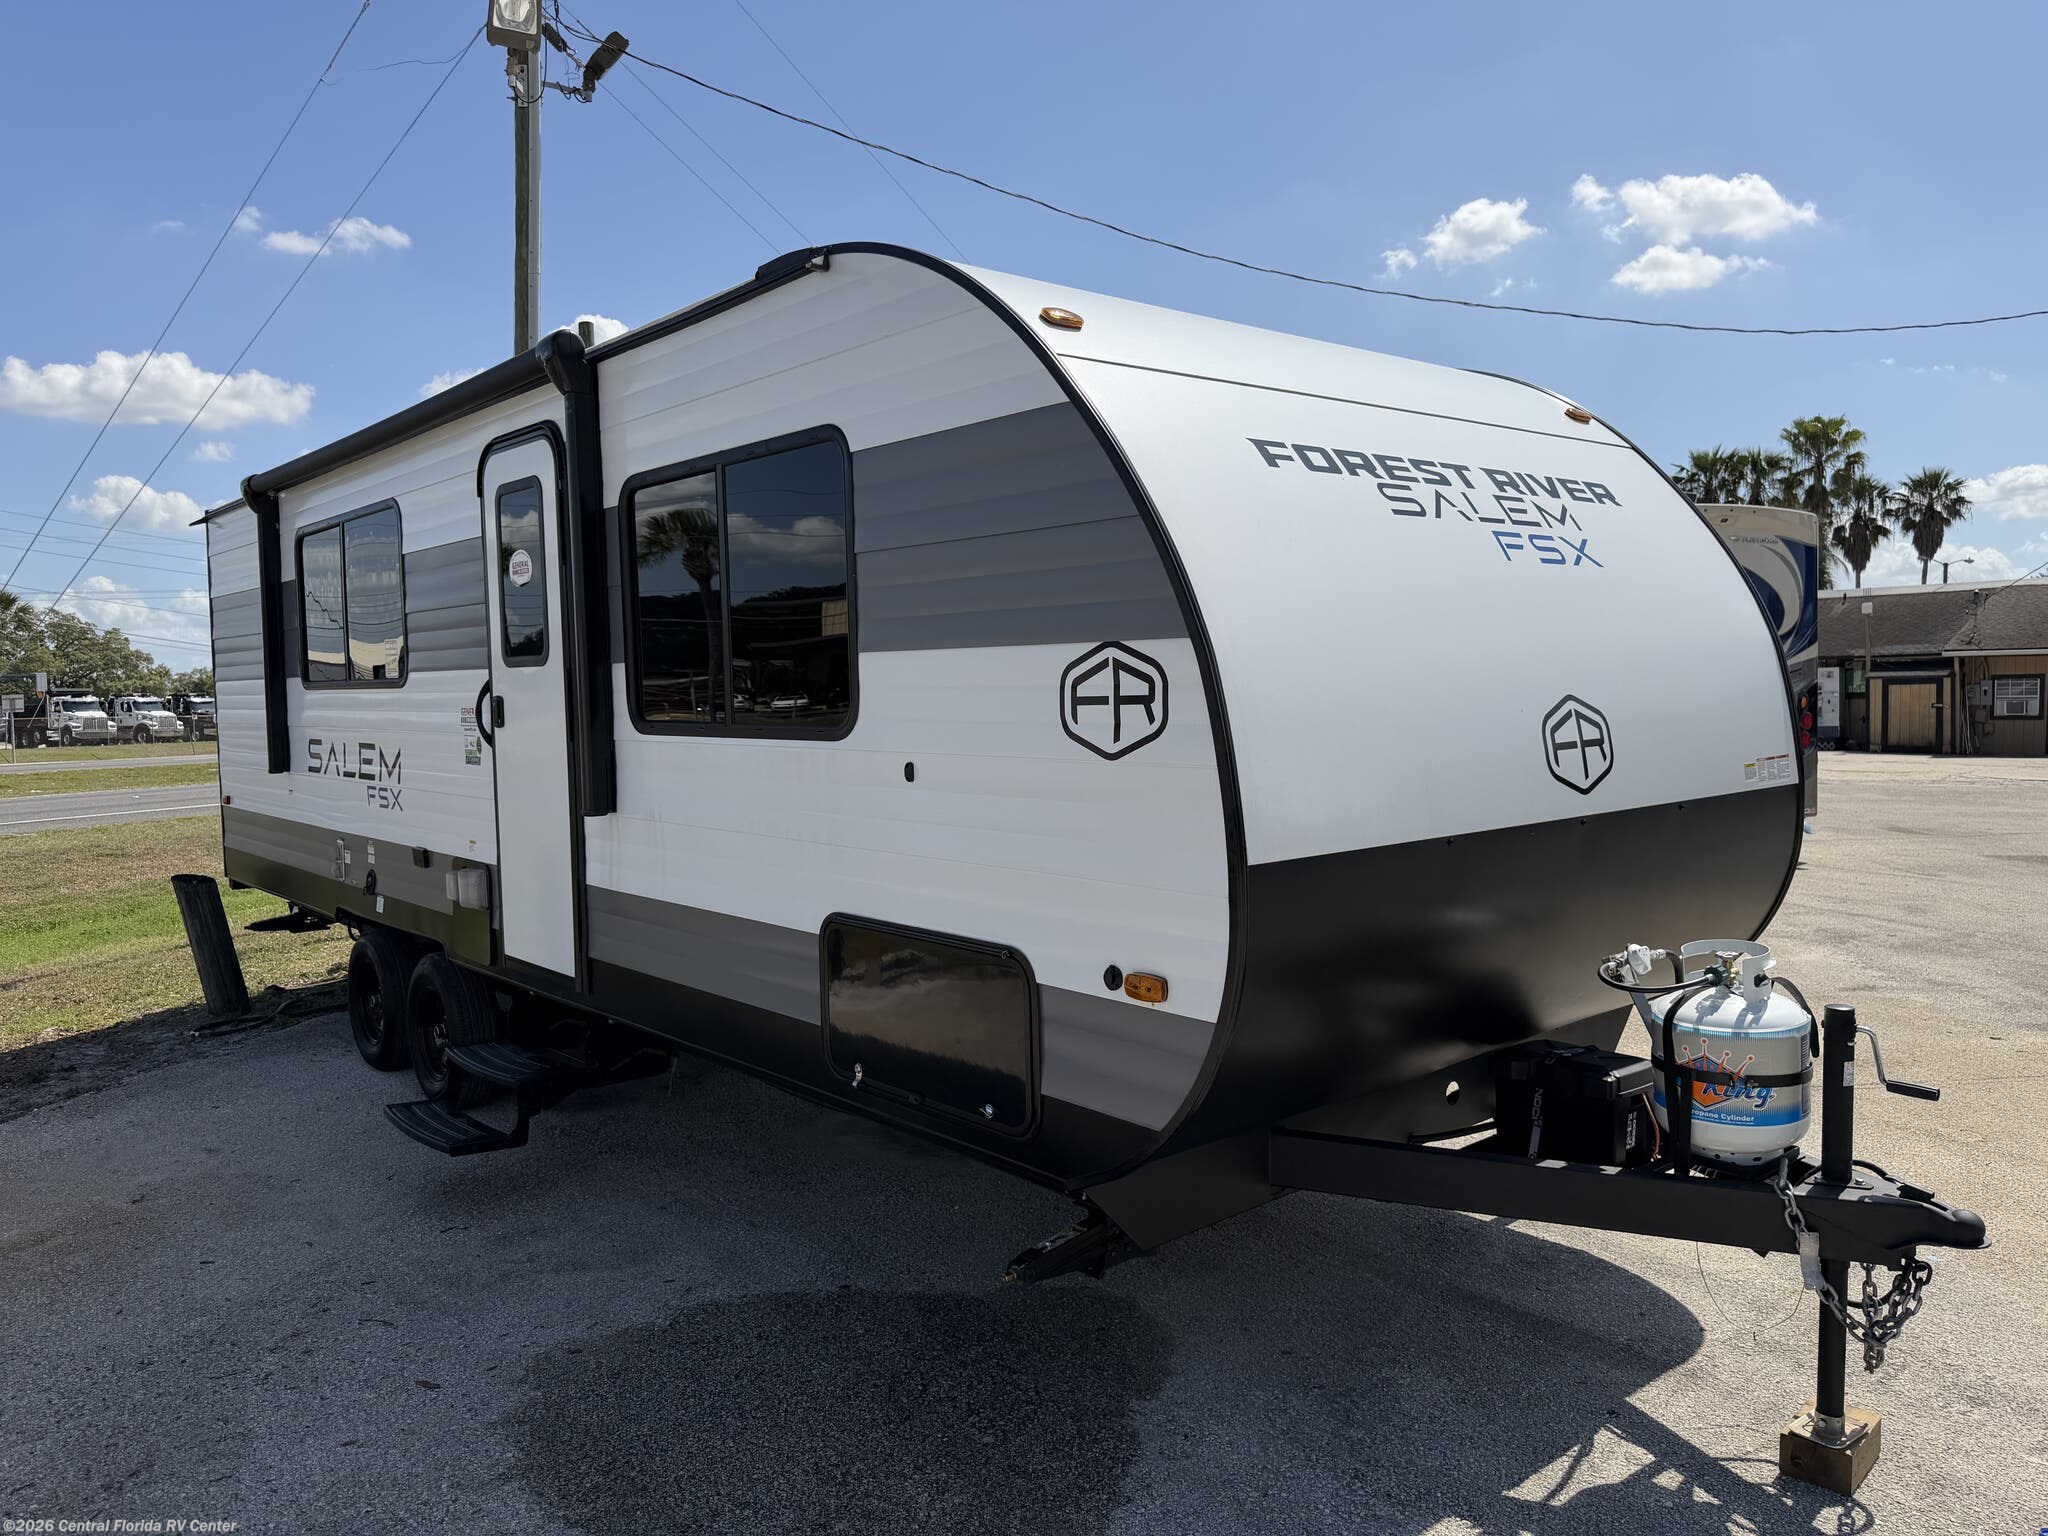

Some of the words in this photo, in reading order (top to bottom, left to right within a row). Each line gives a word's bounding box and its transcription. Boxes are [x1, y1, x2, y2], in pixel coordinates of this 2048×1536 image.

[1246, 437, 1475, 489] FOREST
[1479, 467, 1623, 507] RIVER
[1377, 482, 1582, 531] SALEM
[1491, 530, 1604, 567] FSX
[308, 738, 402, 785] SALEM
[366, 785, 403, 811] FSX
[1691, 1109, 1718, 1118] ropane
[1721, 1113, 1755, 1121] Cylinder
